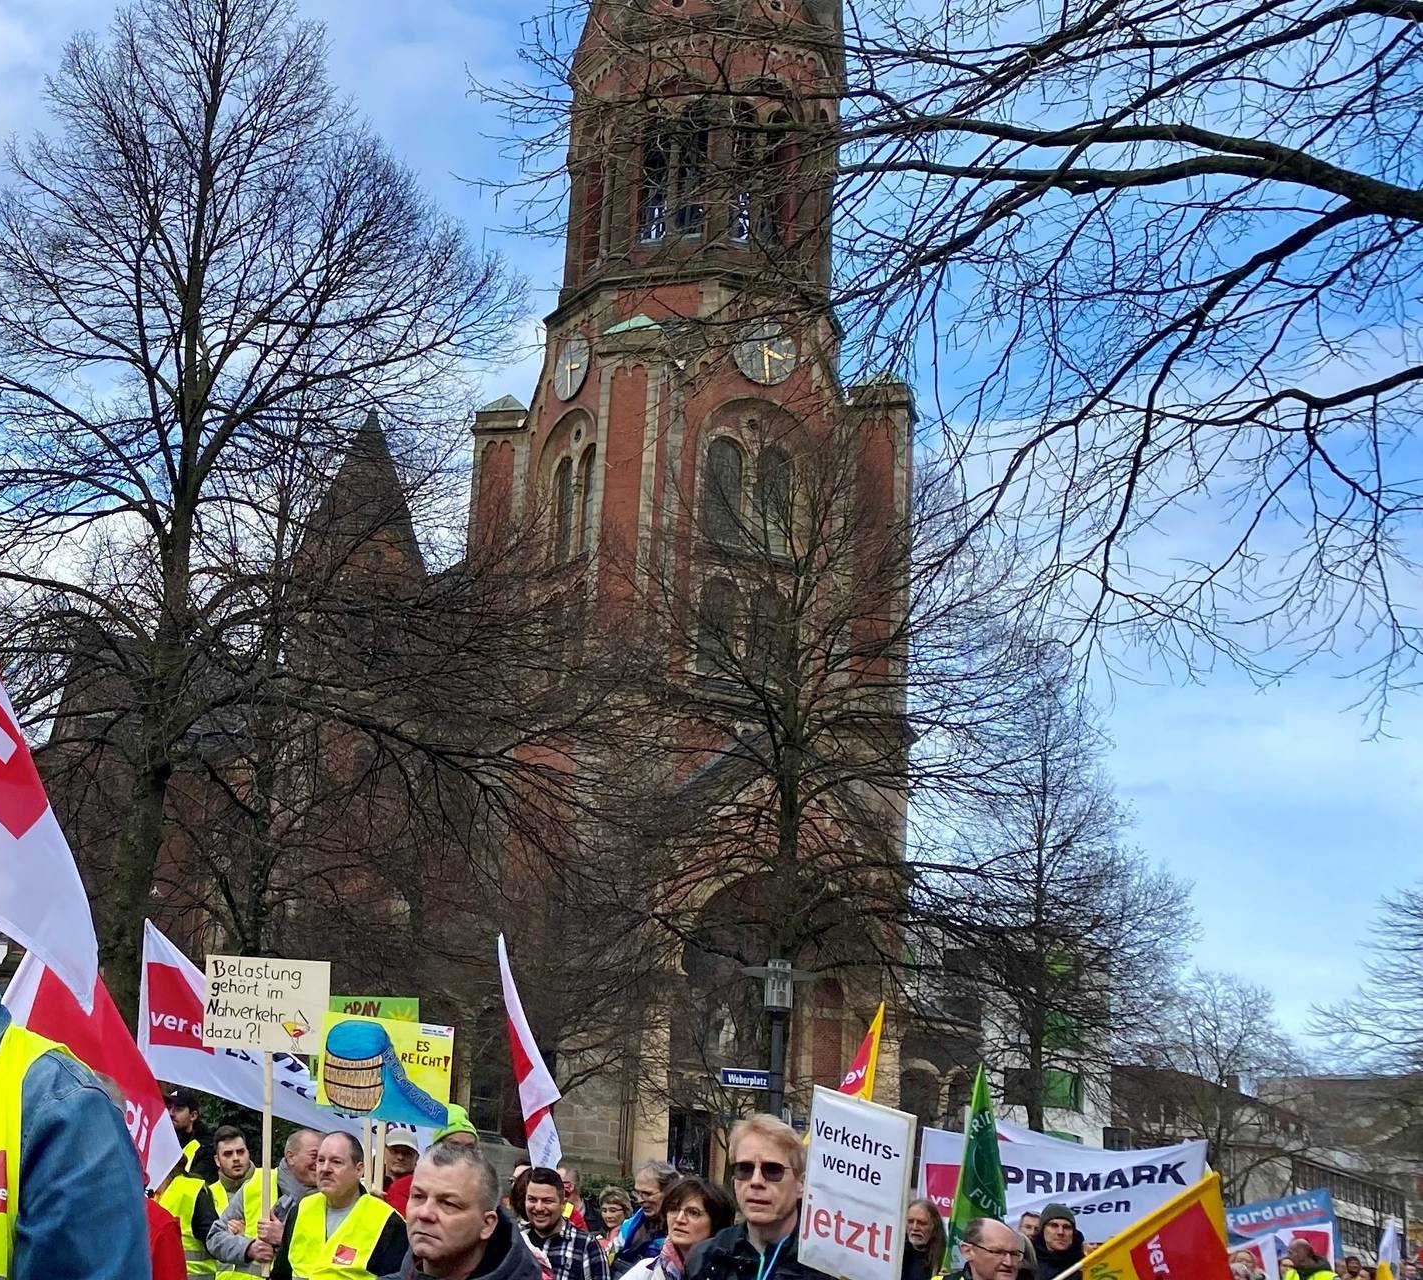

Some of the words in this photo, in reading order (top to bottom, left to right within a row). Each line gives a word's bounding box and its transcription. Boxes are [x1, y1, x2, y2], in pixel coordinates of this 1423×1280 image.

[211, 978, 259, 997] gehört
[267, 983, 283, 999] im
[212, 959, 302, 990] Belastung
[206, 999, 286, 1024] Nahverkehr
[205, 1022, 242, 1040] dazu
[417, 1041, 430, 1053] ES
[728, 1073, 768, 1087] Weberplatz
[815, 1118, 900, 1160] Verkehrs-
[822, 1153, 882, 1186] wende
[1001, 1161, 1187, 1194] PRIMARK
[802, 1194, 893, 1263] jetzt!
